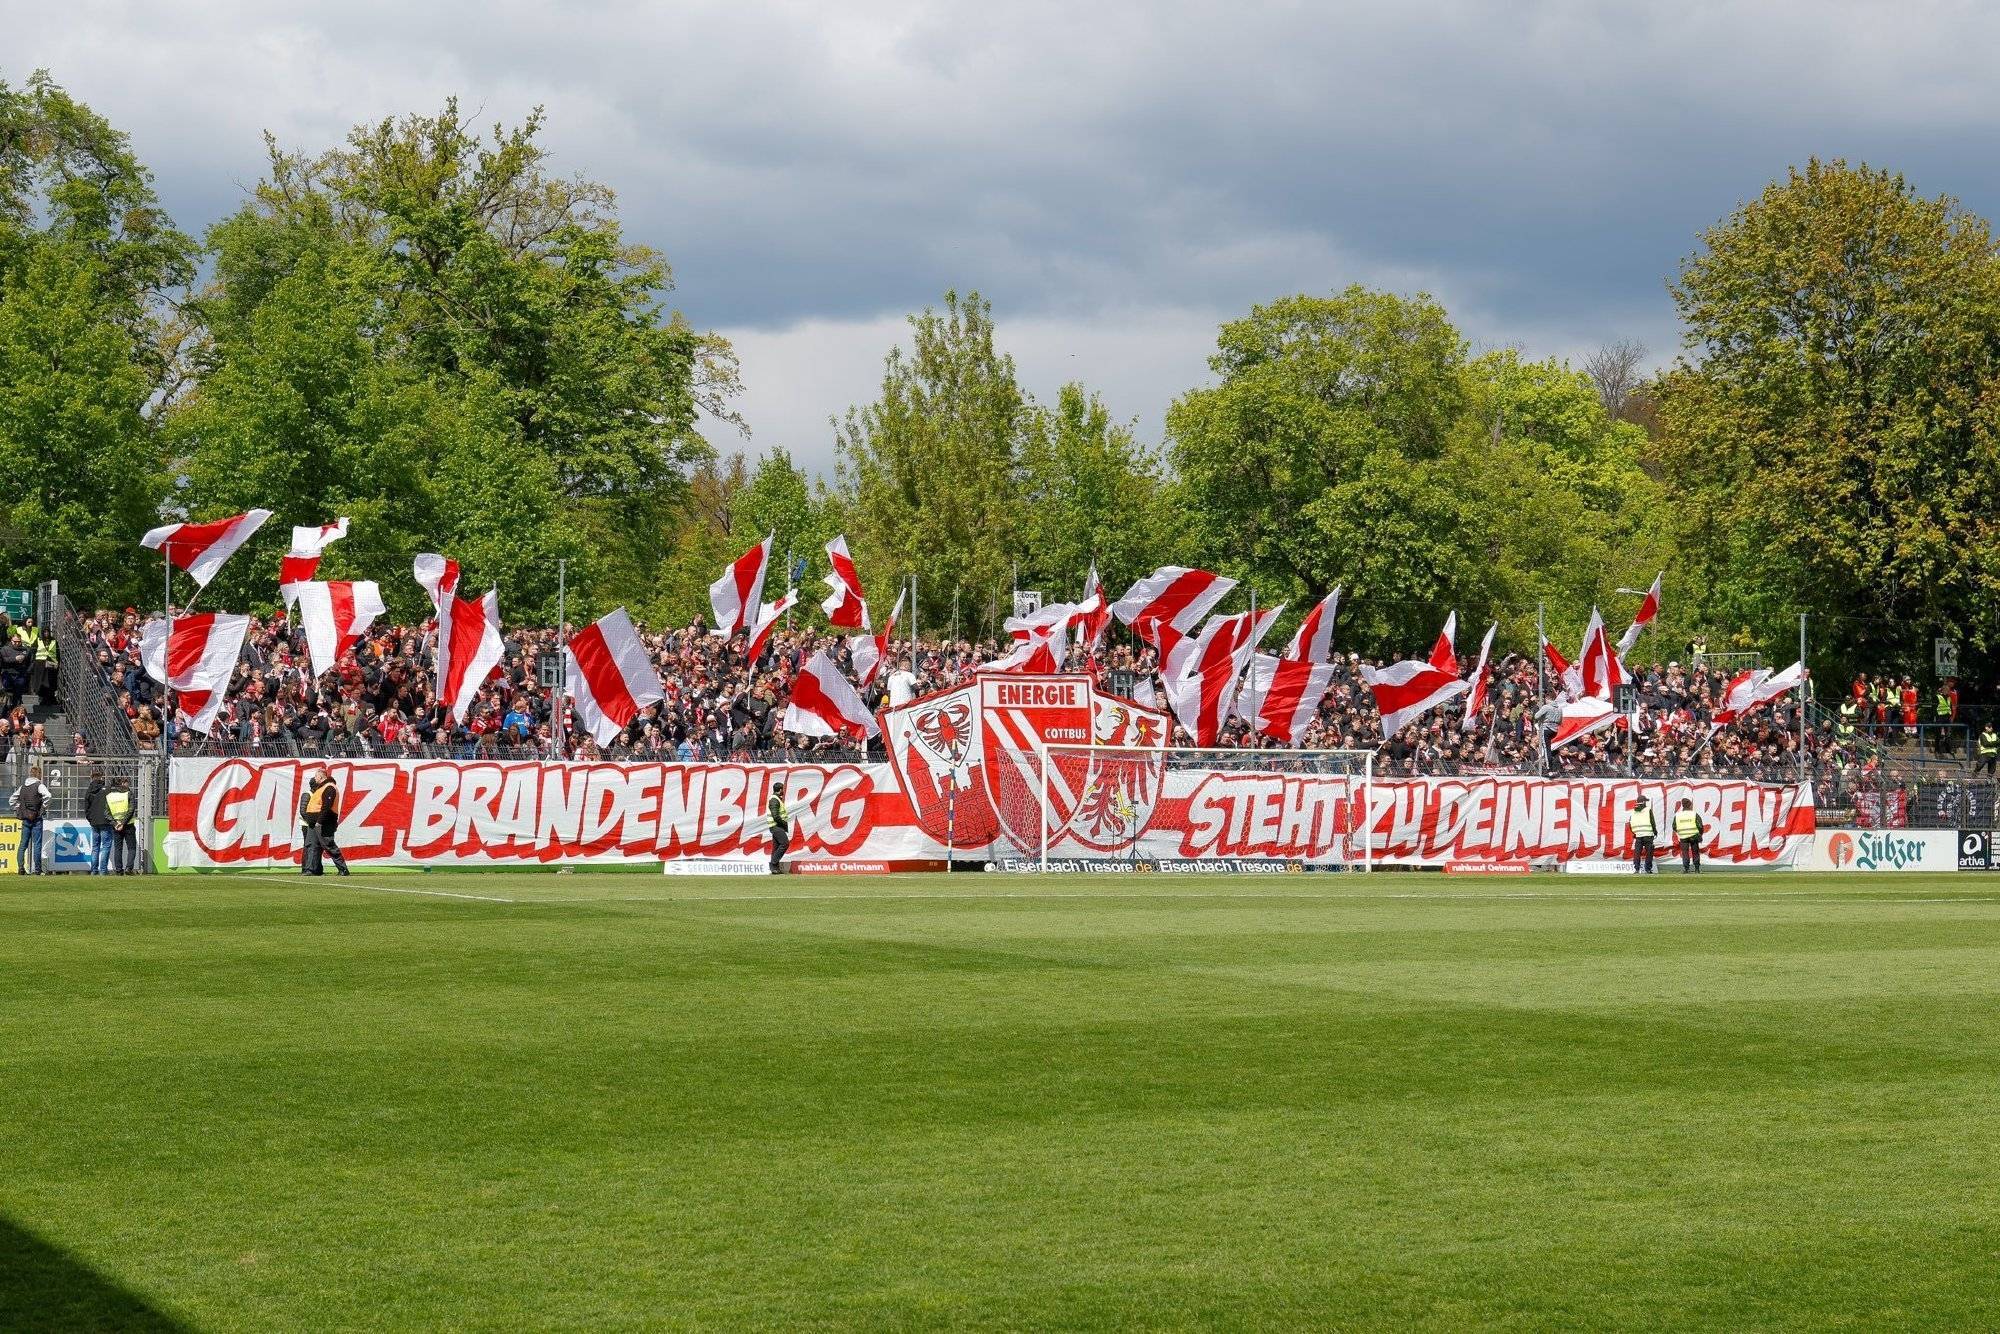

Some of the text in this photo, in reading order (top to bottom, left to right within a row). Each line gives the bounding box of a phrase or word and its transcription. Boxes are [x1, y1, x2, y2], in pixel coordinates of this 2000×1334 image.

[997, 684, 1076, 705] ENERGIE
[1044, 728, 1087, 739] COTTBUS
[50, 769, 61, 787] 2
[403, 763, 872, 858] BRANDENBURG
[1181, 774, 1349, 855] STEHT
[1349, 779, 1427, 854] ZU
[1430, 779, 1603, 857] DEINEN
[1857, 831, 1926, 870] Lübzer
[797, 863, 838, 871] nahkauf
[1004, 860, 1080, 872] Eisenbach
[1158, 860, 1232, 872] Eisenbach
[1959, 855, 1985, 866] artiva
